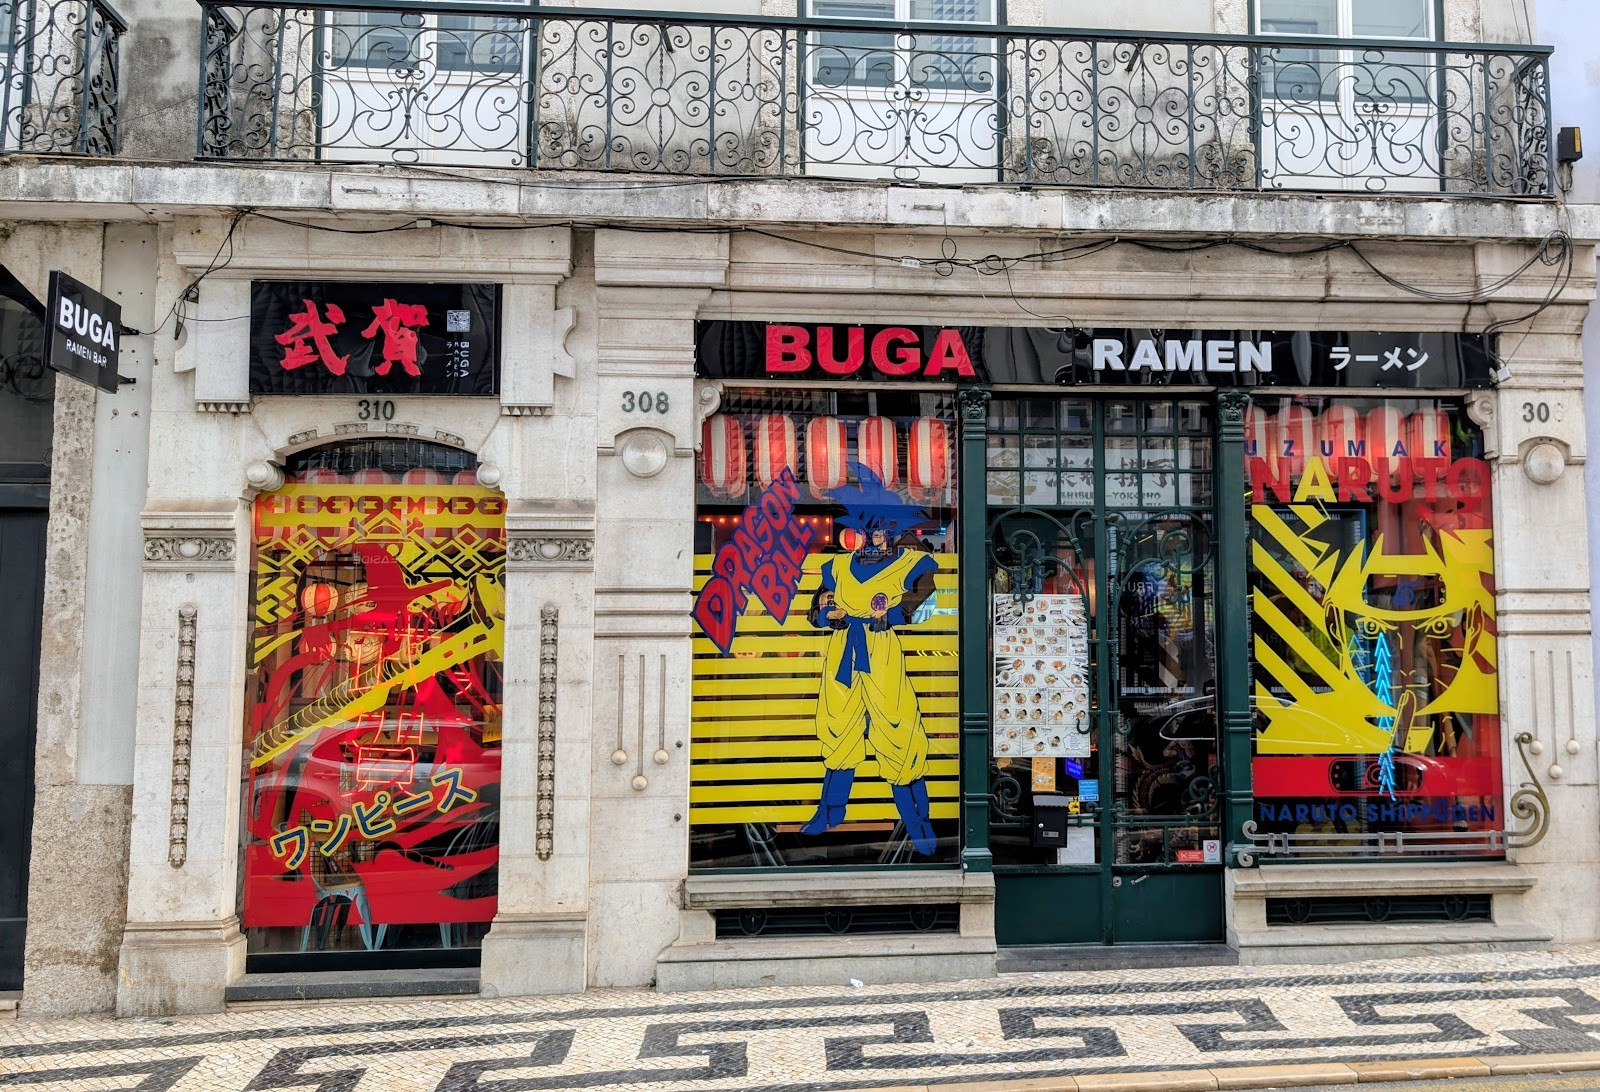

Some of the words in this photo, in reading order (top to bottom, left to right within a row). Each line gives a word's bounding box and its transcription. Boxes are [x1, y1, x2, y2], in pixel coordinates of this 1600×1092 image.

[60, 296, 115, 351] BUGA
[275, 298, 430, 378] 武賀
[66, 339, 92, 361] RAMEN
[93, 351, 107, 368] BAR
[460, 341, 470, 378] BUGA
[766, 325, 976, 377] BUGA
[1092, 338, 1272, 372] RAMEN
[1329, 346, 1428, 371] ラーメン
[358, 400, 395, 420] 310
[621, 390, 670, 414] 308
[1251, 456, 1491, 504] NARUTO
[690, 465, 800, 656] DRAGON
[751, 521, 814, 626] BALL
[269, 768, 477, 869] ワンピース
[1260, 804, 1357, 822] NARUTO
